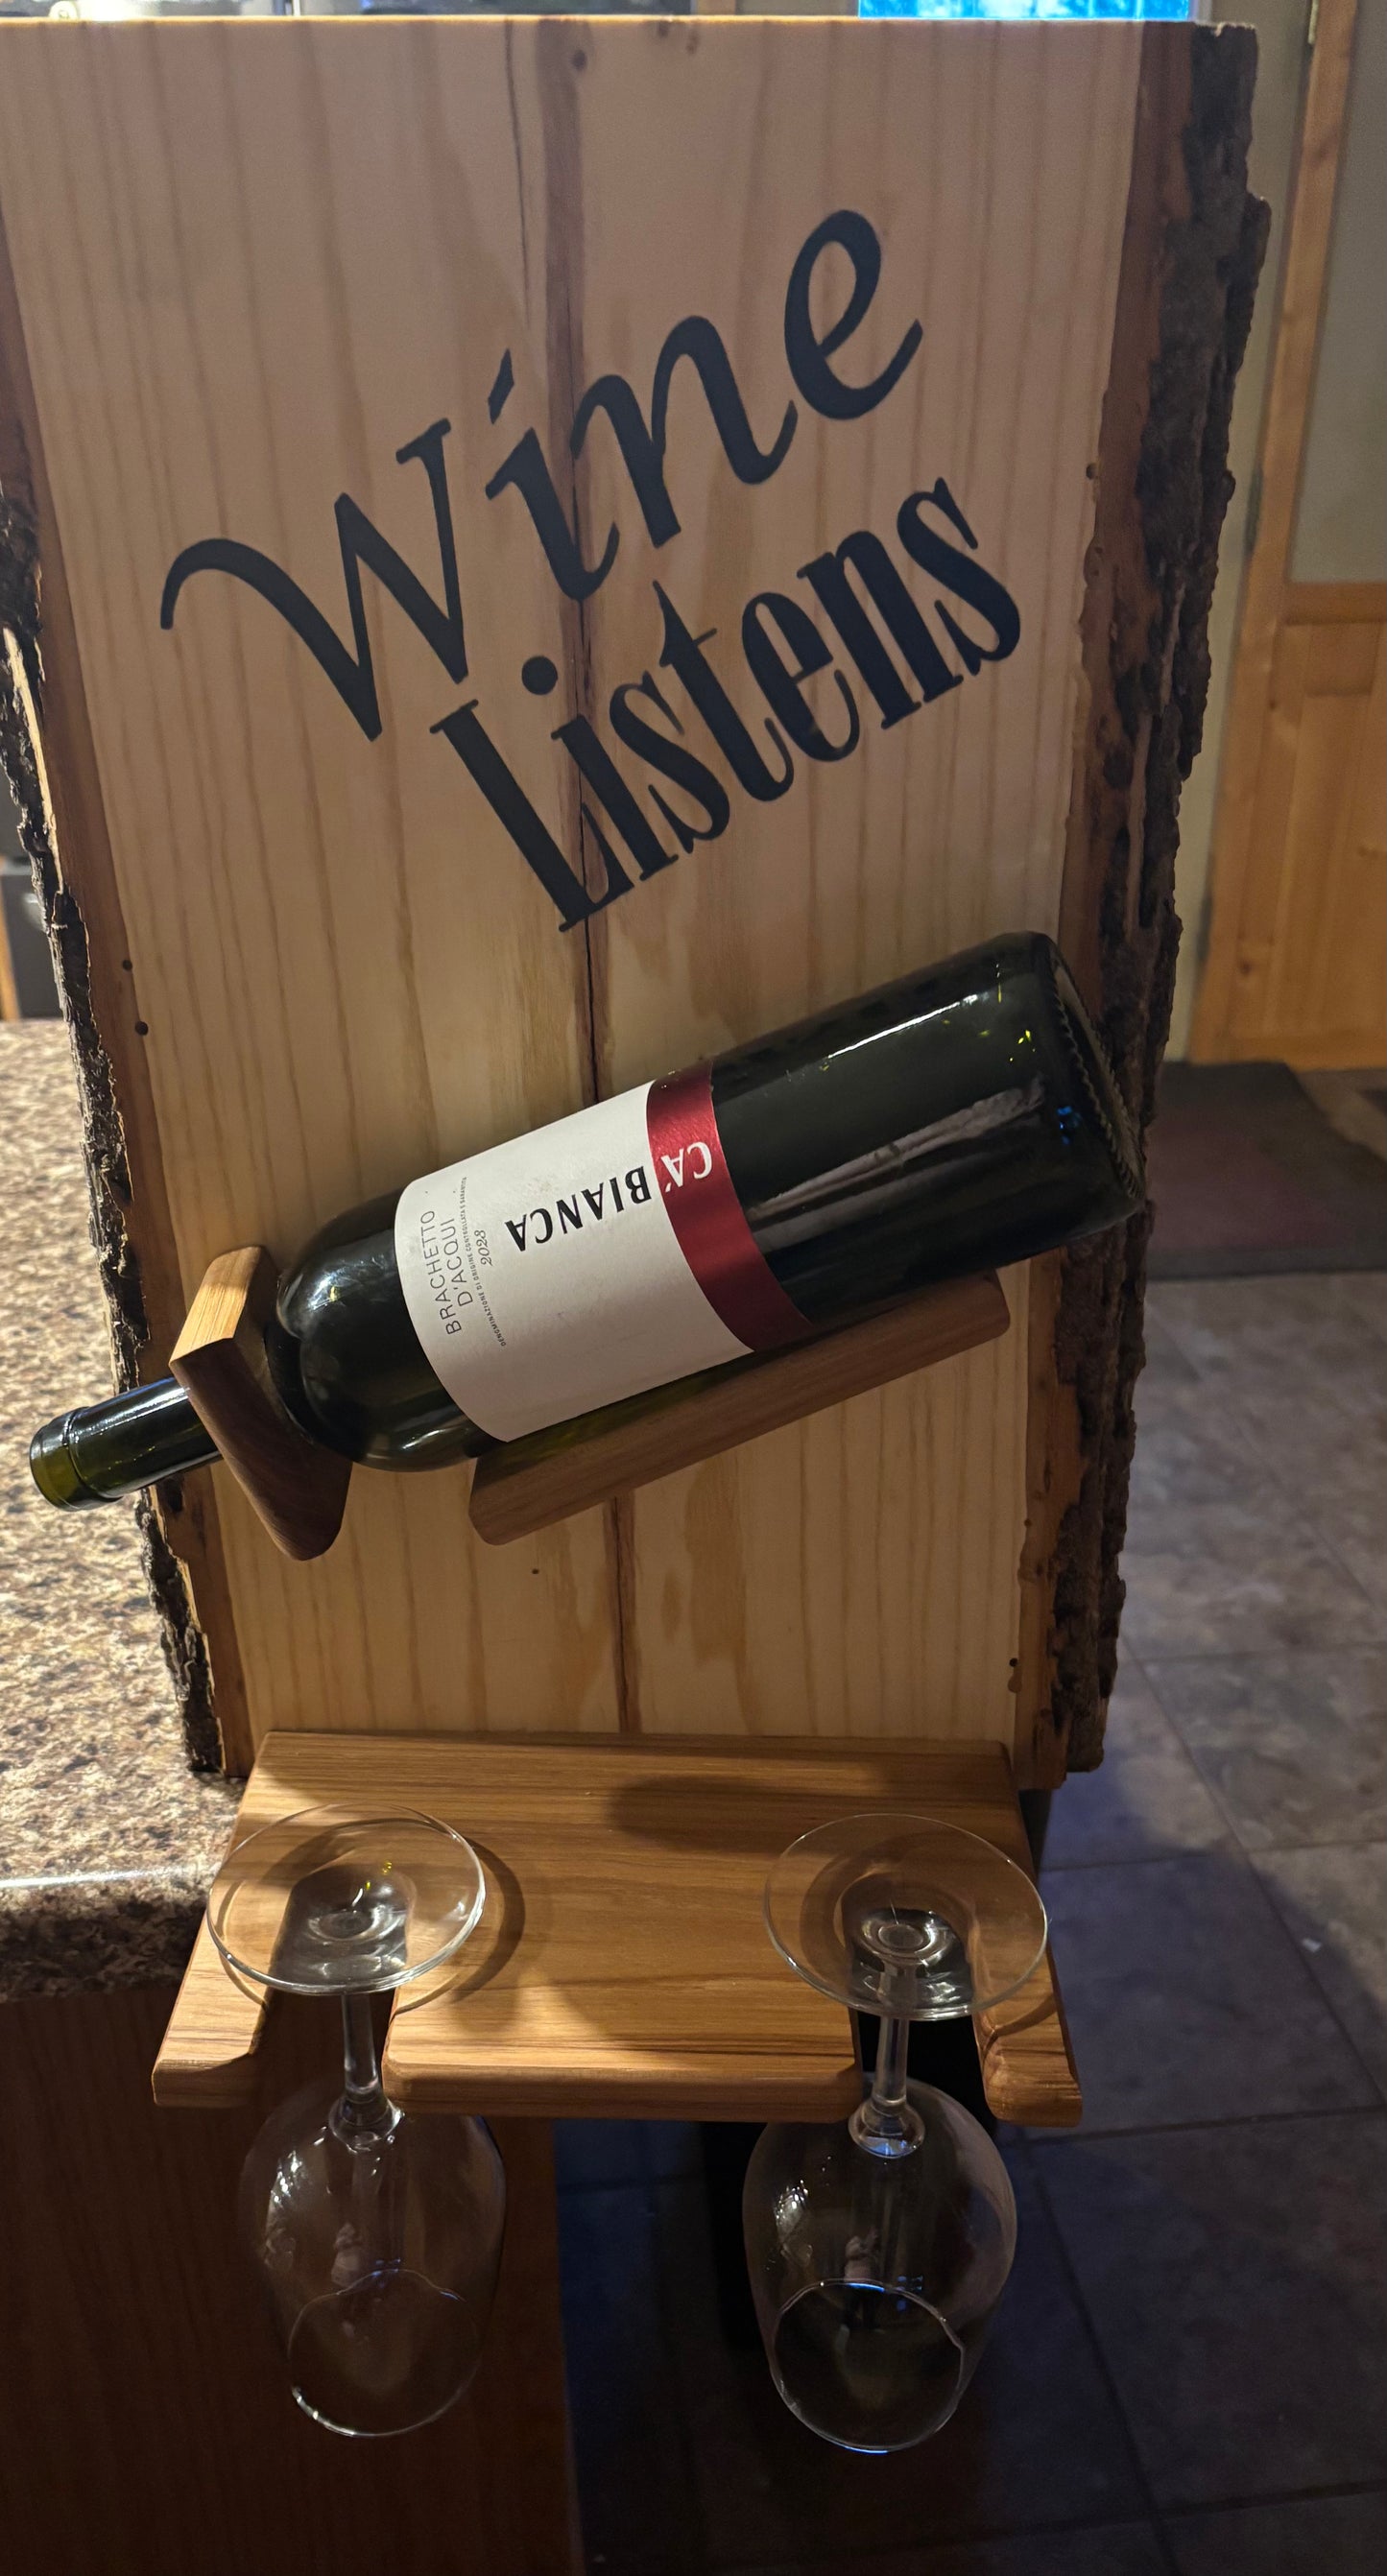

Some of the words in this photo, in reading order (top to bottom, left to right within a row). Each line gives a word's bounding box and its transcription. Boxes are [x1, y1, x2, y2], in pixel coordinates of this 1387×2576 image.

[159, 208, 923, 742] Wine
[429, 476, 1021, 933] Listens
[440, 1217, 474, 1307] D'ACQUI
[504, 1165, 653, 1252] BIANCA
[419, 1210, 463, 1335] BRACHETTO
[478, 1291, 507, 1348] DENOMINAZIONE
